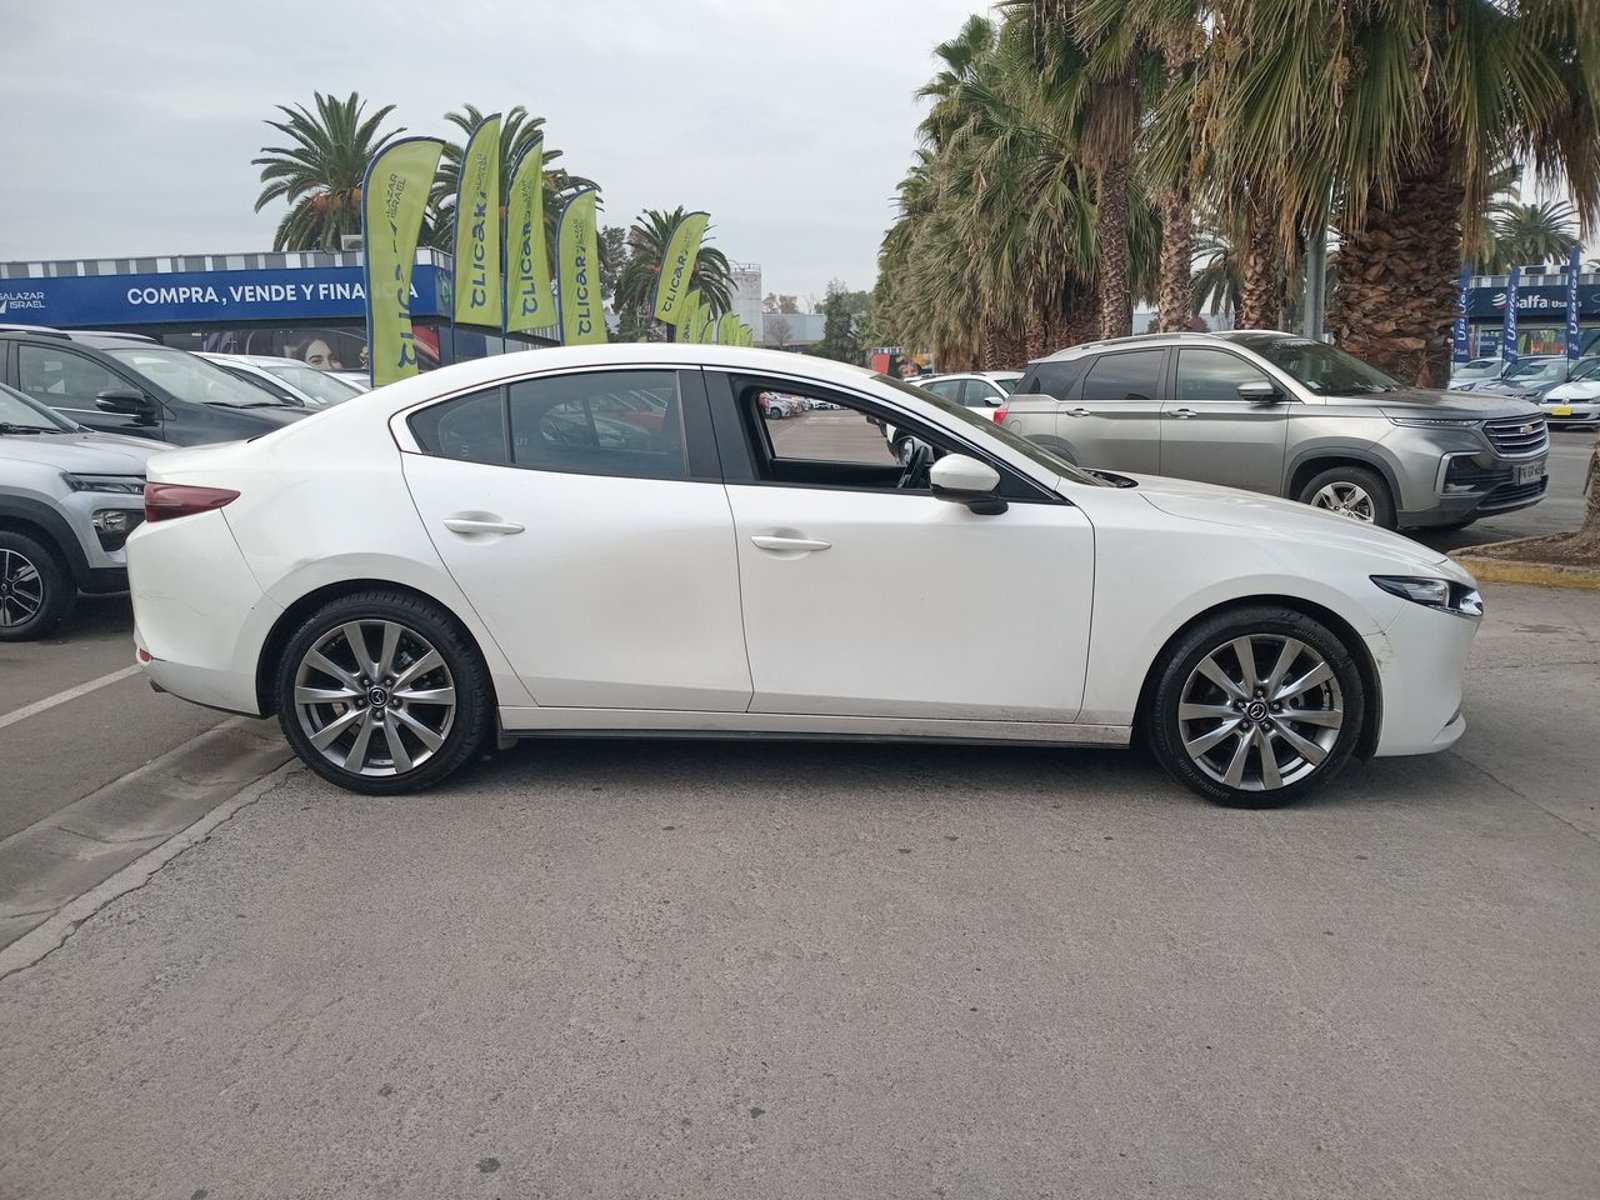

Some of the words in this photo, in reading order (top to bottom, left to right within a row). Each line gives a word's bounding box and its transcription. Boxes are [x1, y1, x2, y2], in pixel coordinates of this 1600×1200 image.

[229, 285, 297, 302] VENDE
[300, 284, 315, 300] Y
[319, 283, 420, 301] FINAA
[9, 300, 46, 309] ISRAEL
